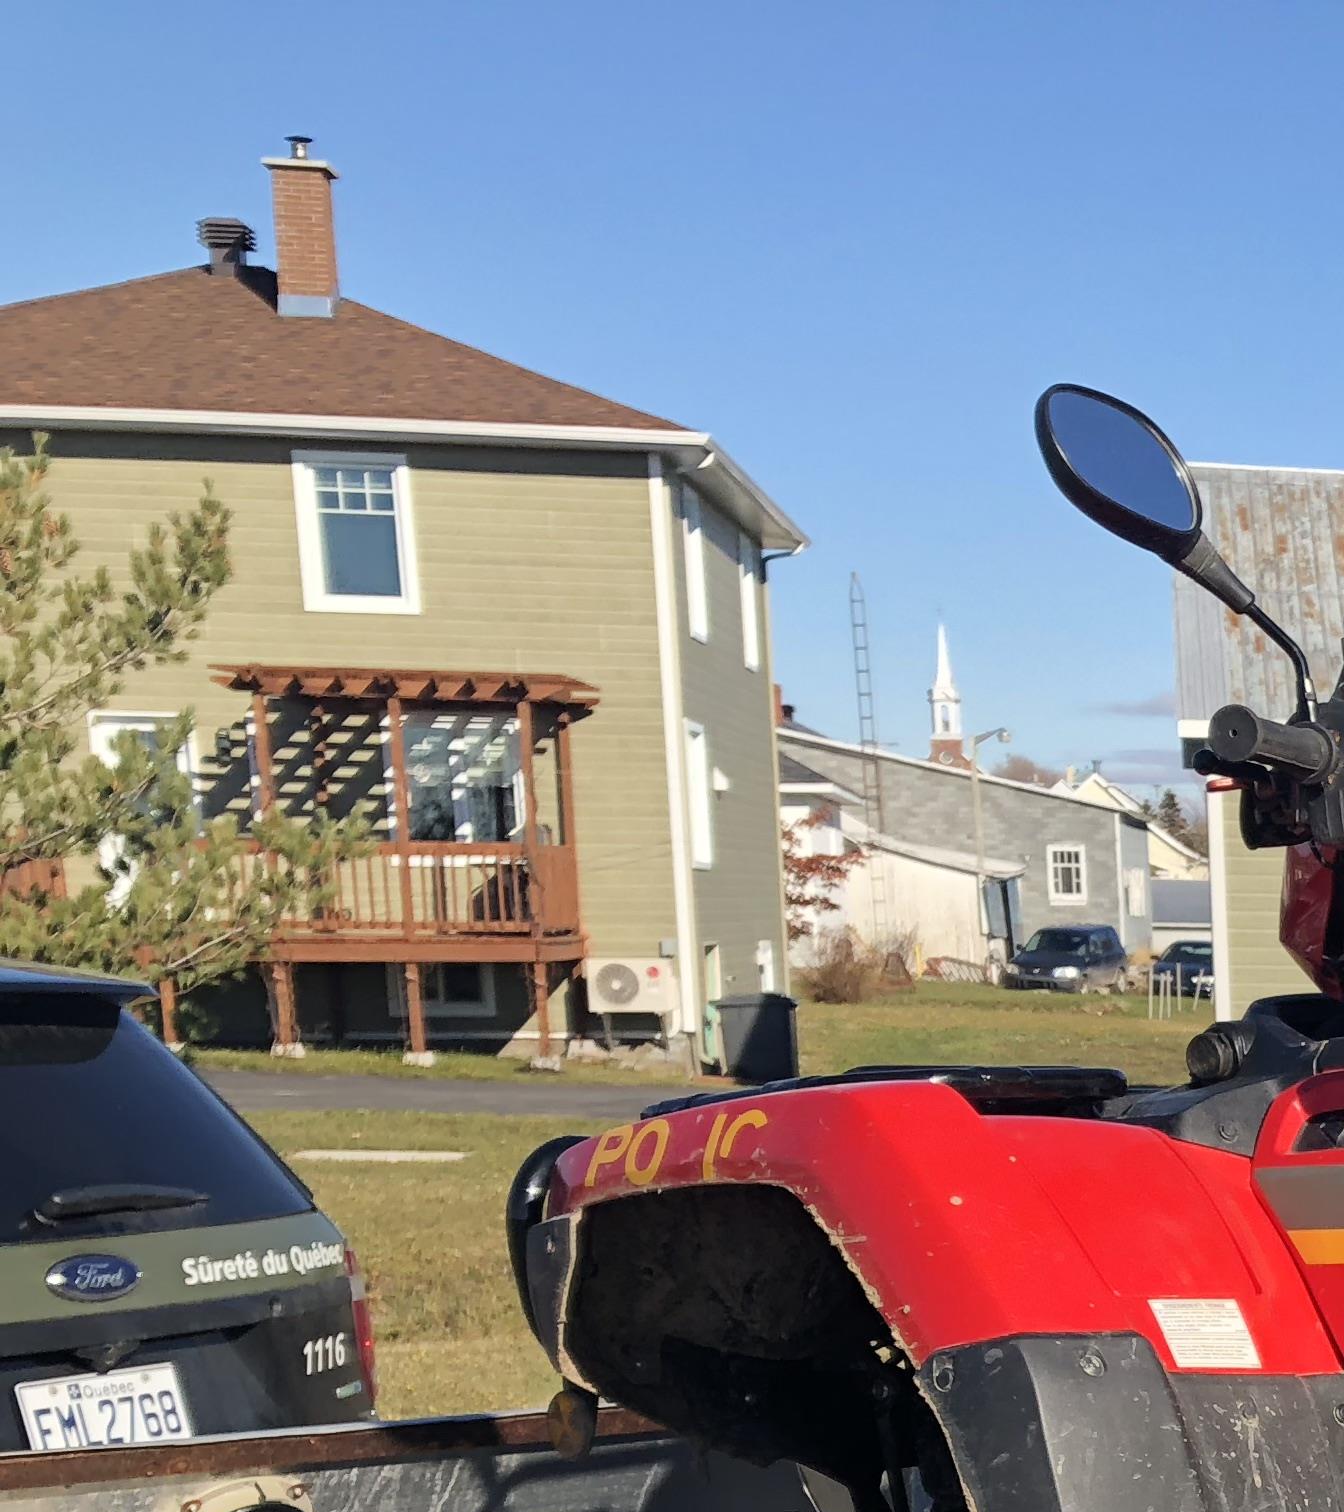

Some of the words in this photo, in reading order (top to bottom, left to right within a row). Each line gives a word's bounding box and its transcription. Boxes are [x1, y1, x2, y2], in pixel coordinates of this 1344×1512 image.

[75, 1263, 124, 1290] Ford
[182, 1251, 259, 1286] Sûreté
[262, 1248, 289, 1276] du
[290, 1241, 344, 1275] Québec
[303, 1331, 345, 1376] 1116
[82, 1380, 135, 1399] Québec
